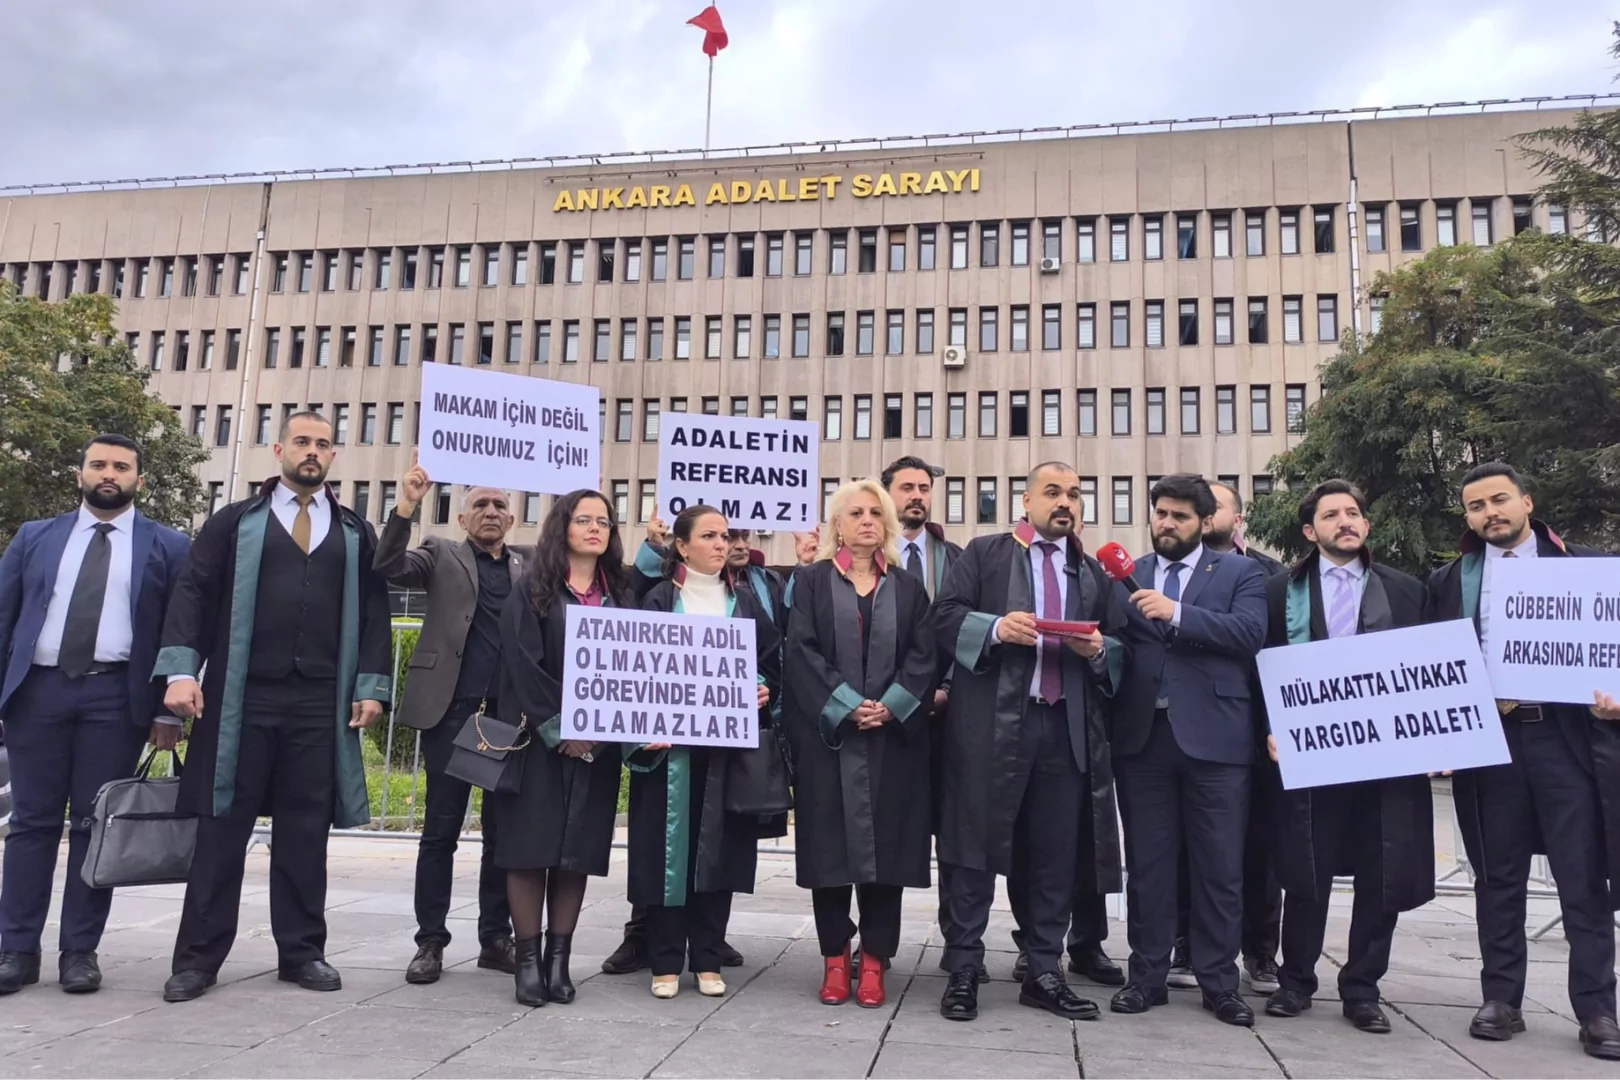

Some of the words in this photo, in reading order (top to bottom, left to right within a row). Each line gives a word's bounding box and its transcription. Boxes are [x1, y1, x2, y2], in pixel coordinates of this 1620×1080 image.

[553, 184, 696, 212] ANKARA
[705, 175, 842, 206] ADALET
[851, 168, 980, 198] SARAYI
[433, 391, 498, 420] MAKAM
[502, 396, 537, 428] İÇİN
[541, 404, 589, 433] DEĞİL
[432, 429, 536, 462] ONURUMUZ
[547, 438, 588, 470] İÇİN!
[670, 426, 809, 455] ADALETİN
[670, 461, 808, 489] REFERANSI
[1505, 590, 1583, 621] CÜBBENİN
[576, 617, 694, 647] ATANIRKEN
[701, 623, 747, 651] ADİL
[575, 646, 748, 680] OLMAYANLAR
[1502, 639, 1585, 668] ARKASINDA
[574, 673, 697, 706] GÖREVİNDE
[702, 680, 749, 710] ADİL
[1279, 674, 1389, 709] MÜLAKATTA
[1391, 659, 1468, 694] LİYAKAT
[572, 707, 749, 740] OLAMAZLAR!
[1288, 718, 1382, 753] YARGIDA
[1393, 704, 1484, 741] ADALET!
